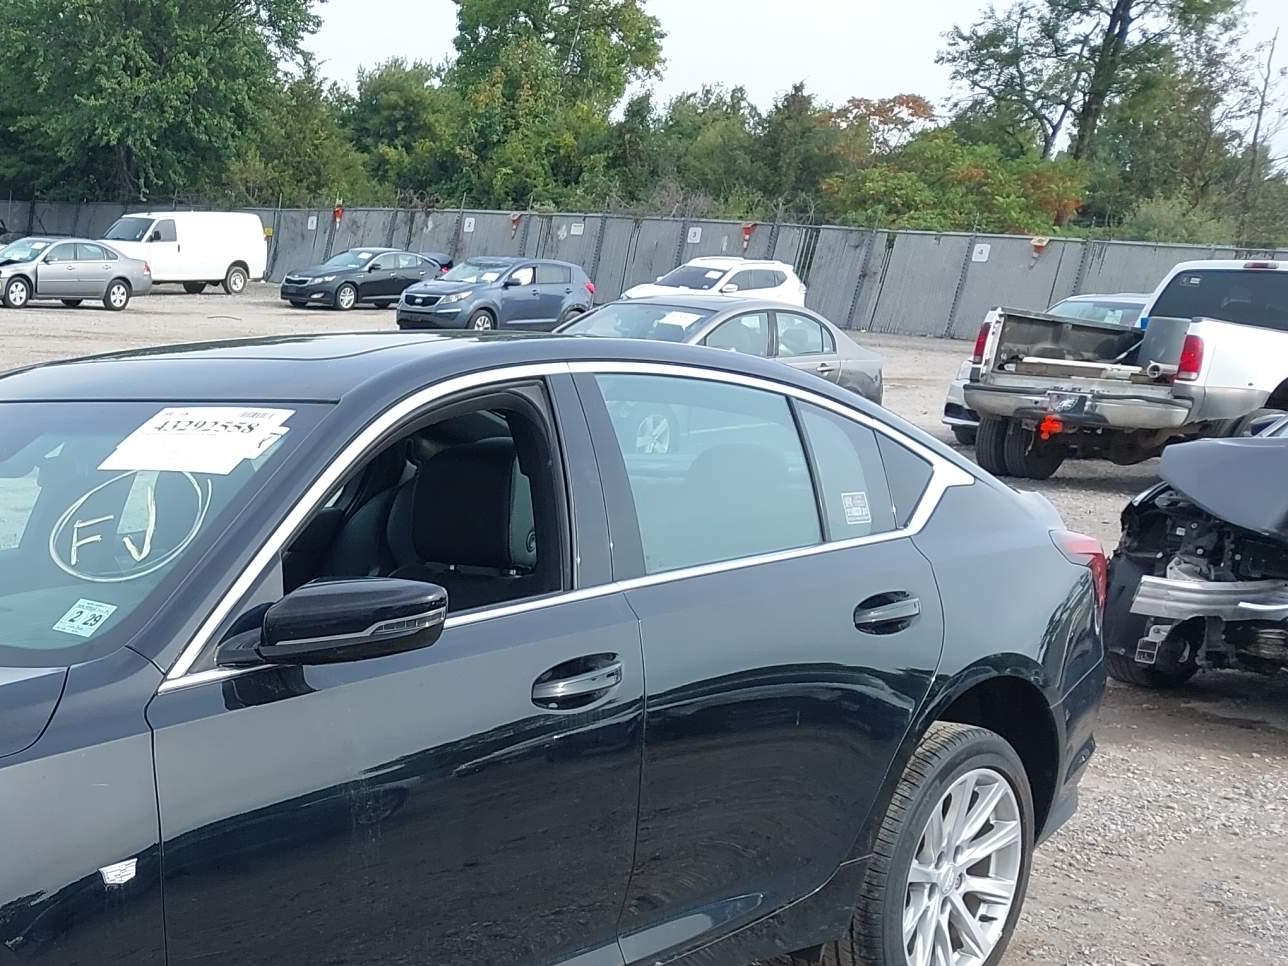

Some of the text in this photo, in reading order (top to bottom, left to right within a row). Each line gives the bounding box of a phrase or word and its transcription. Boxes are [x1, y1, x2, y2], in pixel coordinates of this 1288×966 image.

[154, 419, 260, 434] 43292558
[68, 610, 103, 627] 2 29
